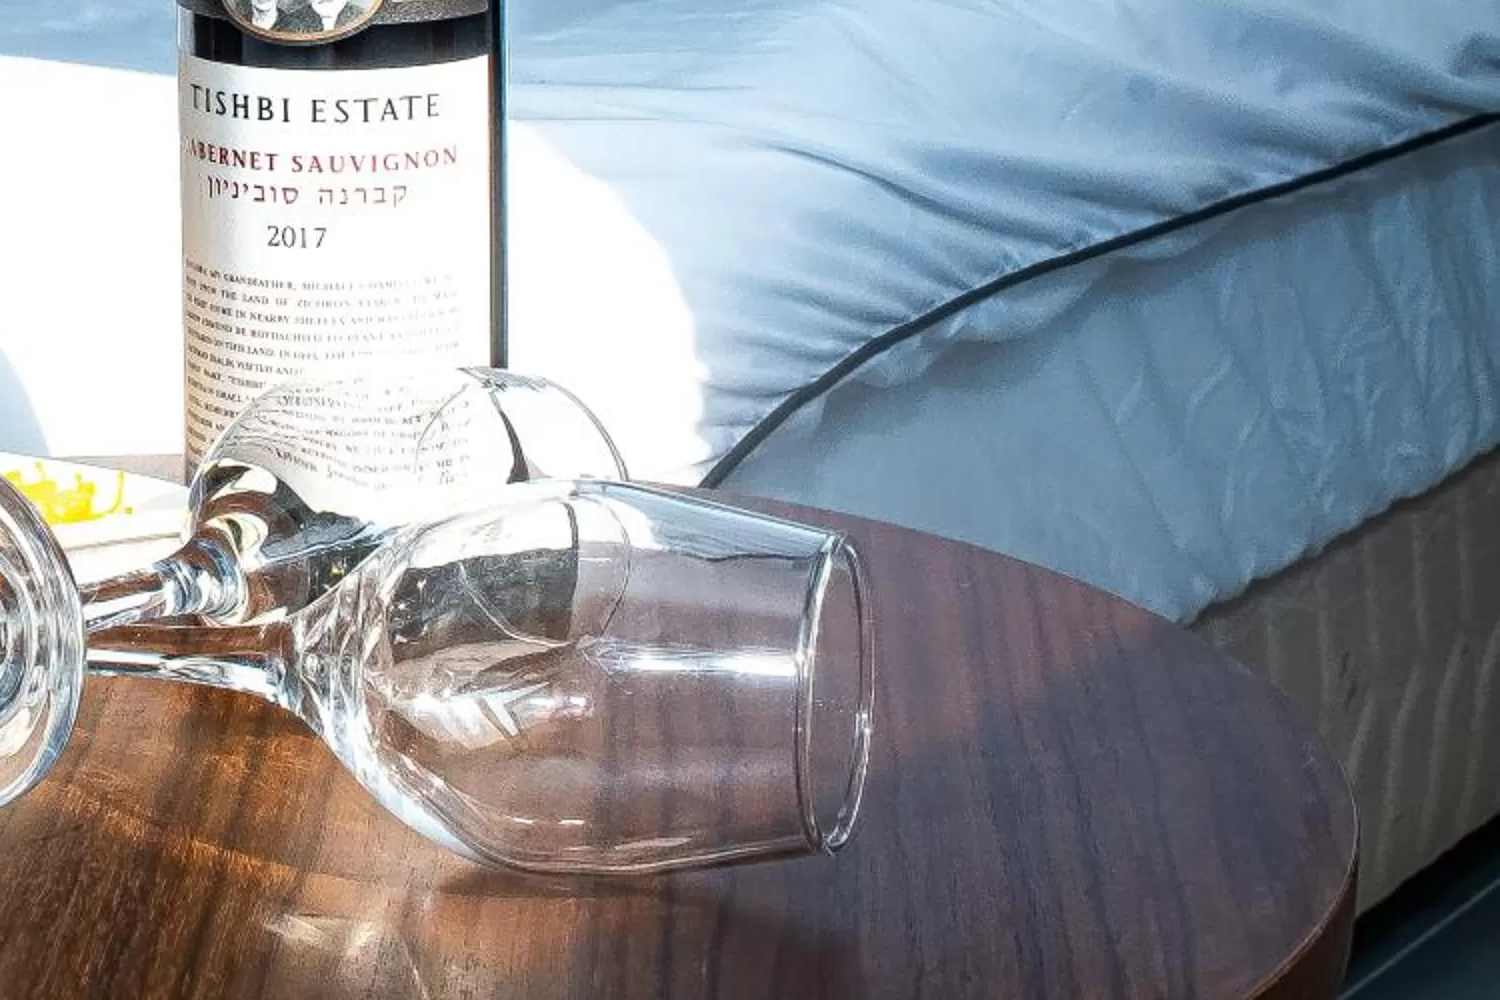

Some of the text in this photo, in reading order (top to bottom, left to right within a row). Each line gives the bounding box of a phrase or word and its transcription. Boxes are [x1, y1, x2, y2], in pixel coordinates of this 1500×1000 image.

[190, 83, 441, 124] TISHBI ESTATE
[291, 145, 459, 174] SAUVIGNON
[318, 184, 408, 208] קברנה
[266, 225, 328, 249] 2017
